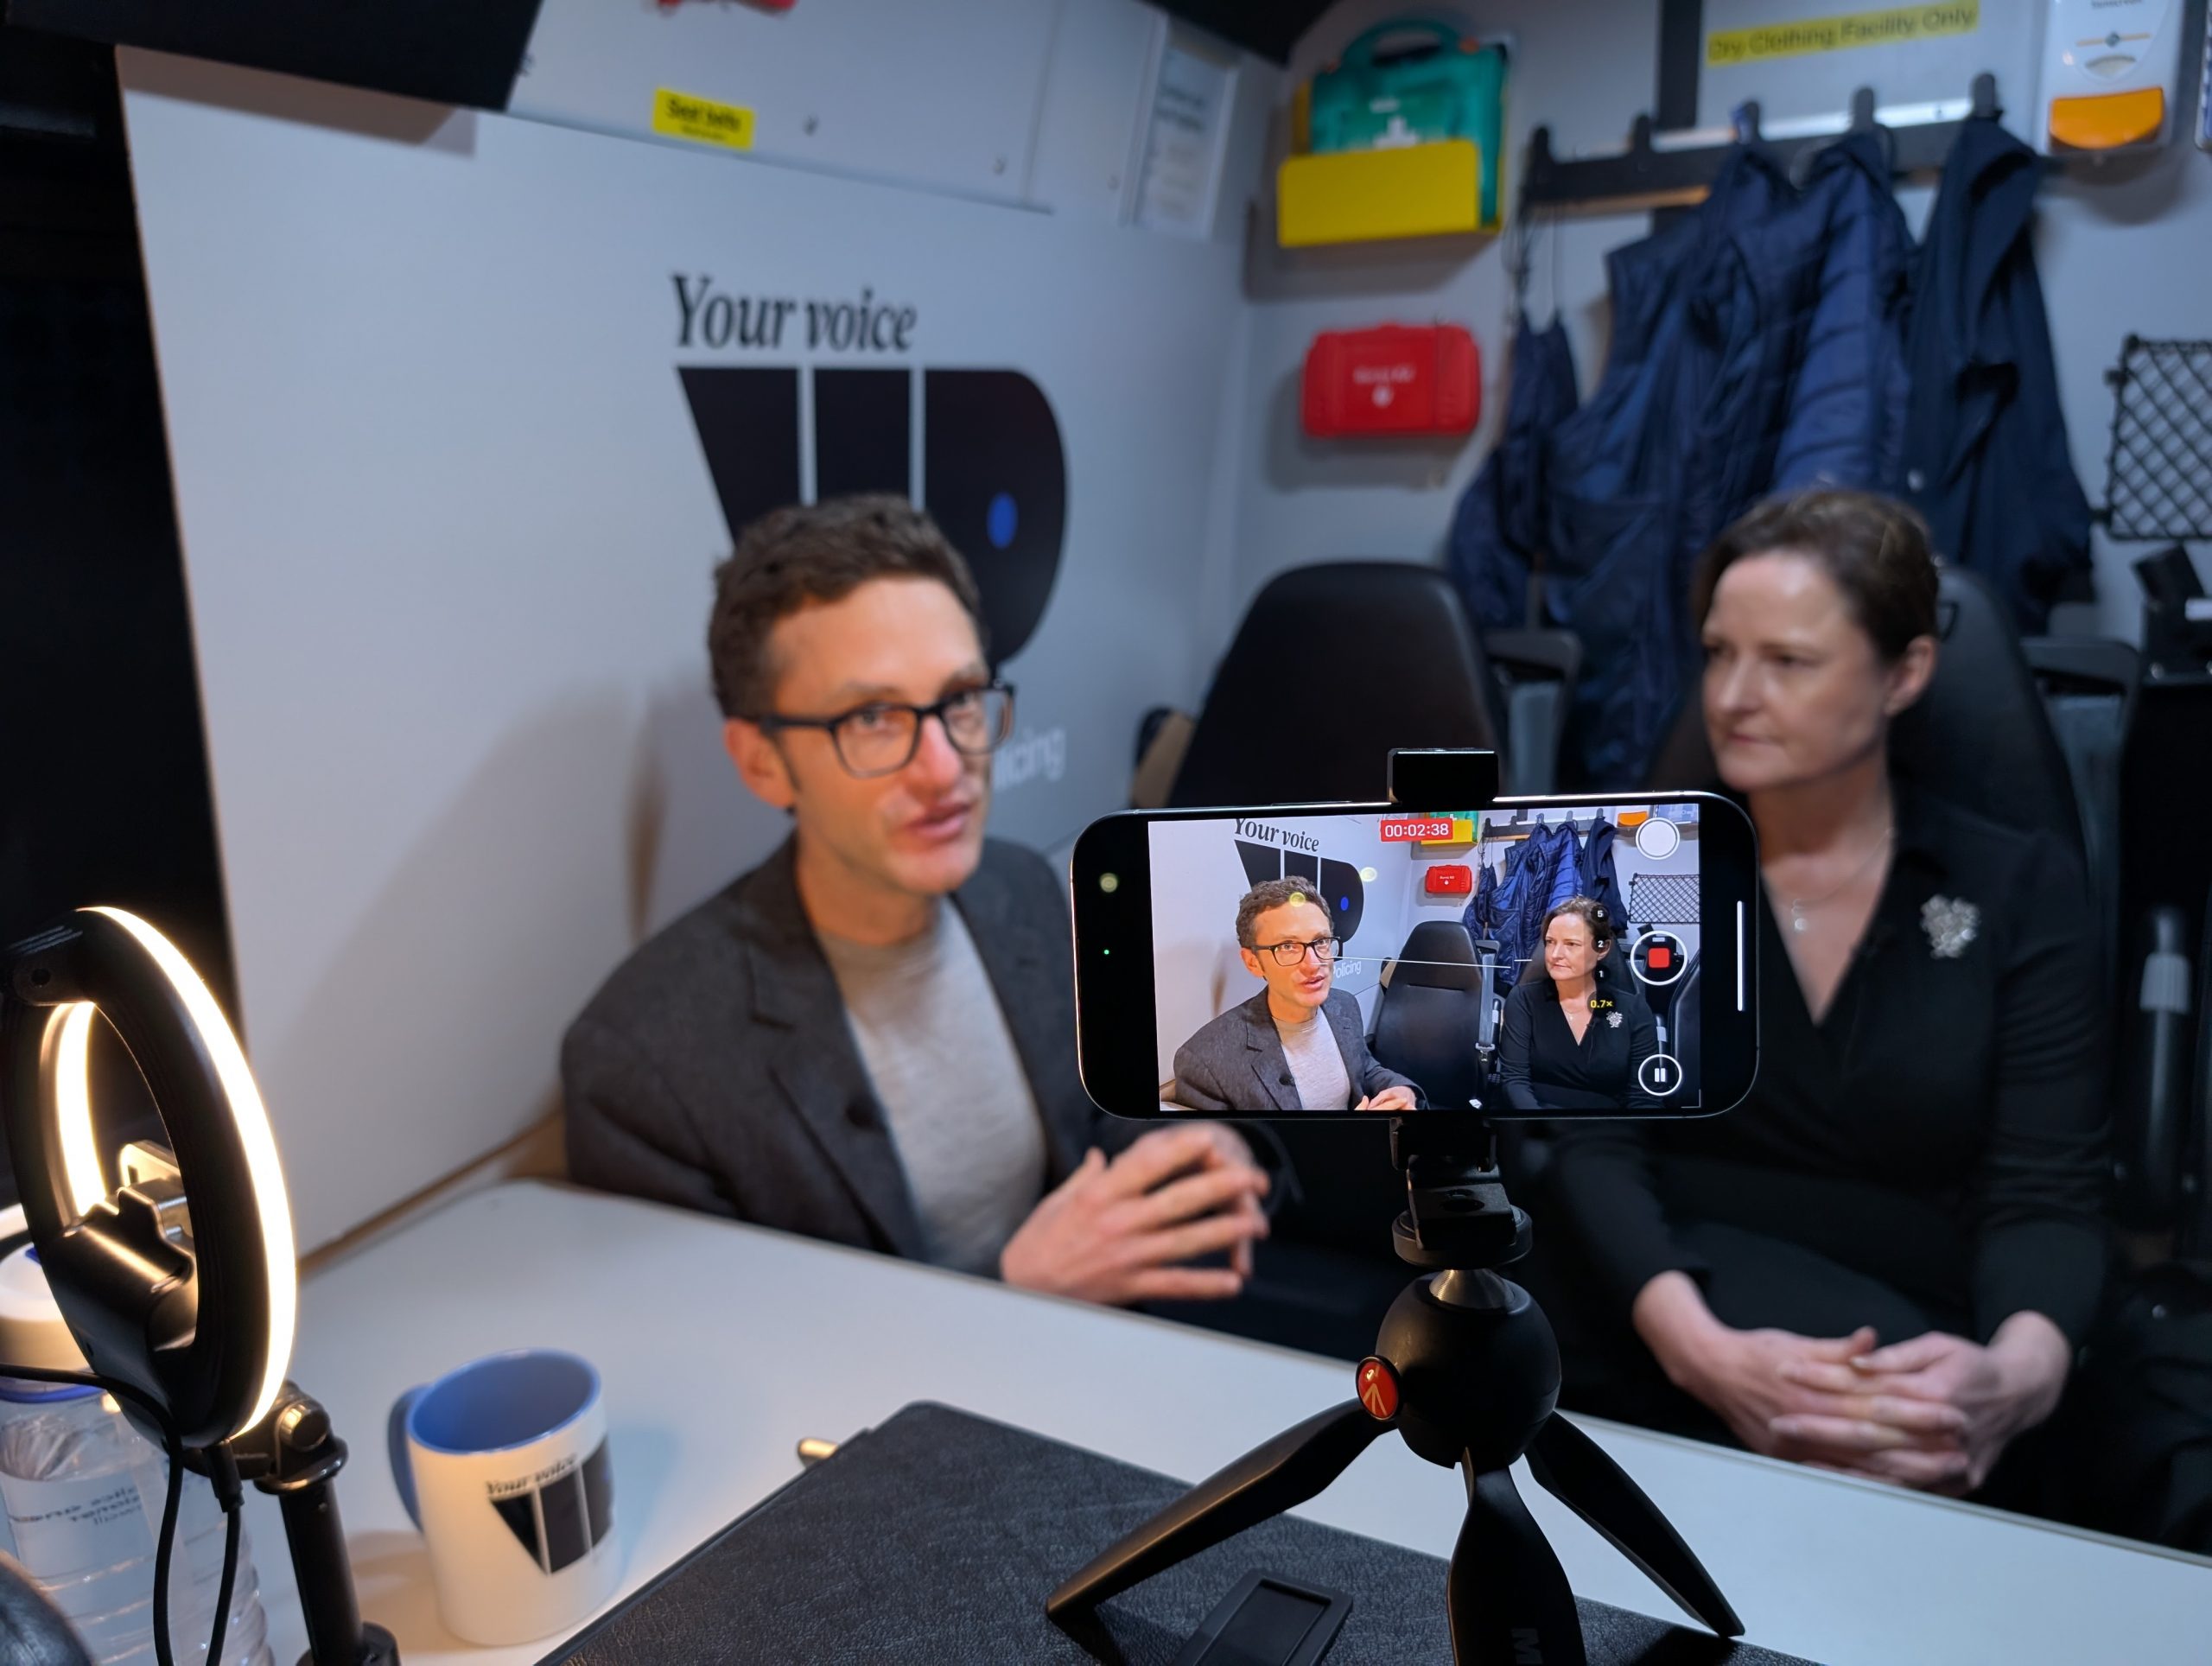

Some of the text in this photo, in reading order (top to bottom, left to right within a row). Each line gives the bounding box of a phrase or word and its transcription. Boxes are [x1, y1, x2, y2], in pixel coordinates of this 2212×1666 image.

[1709, 7, 1975, 62] Dry Clothing Facility Only
[672, 273, 918, 352] Your voice
[1234, 817, 1320, 852] Your voice
[1384, 823, 1449, 837] 00:02:38
[1333, 960, 1362, 978] olicing
